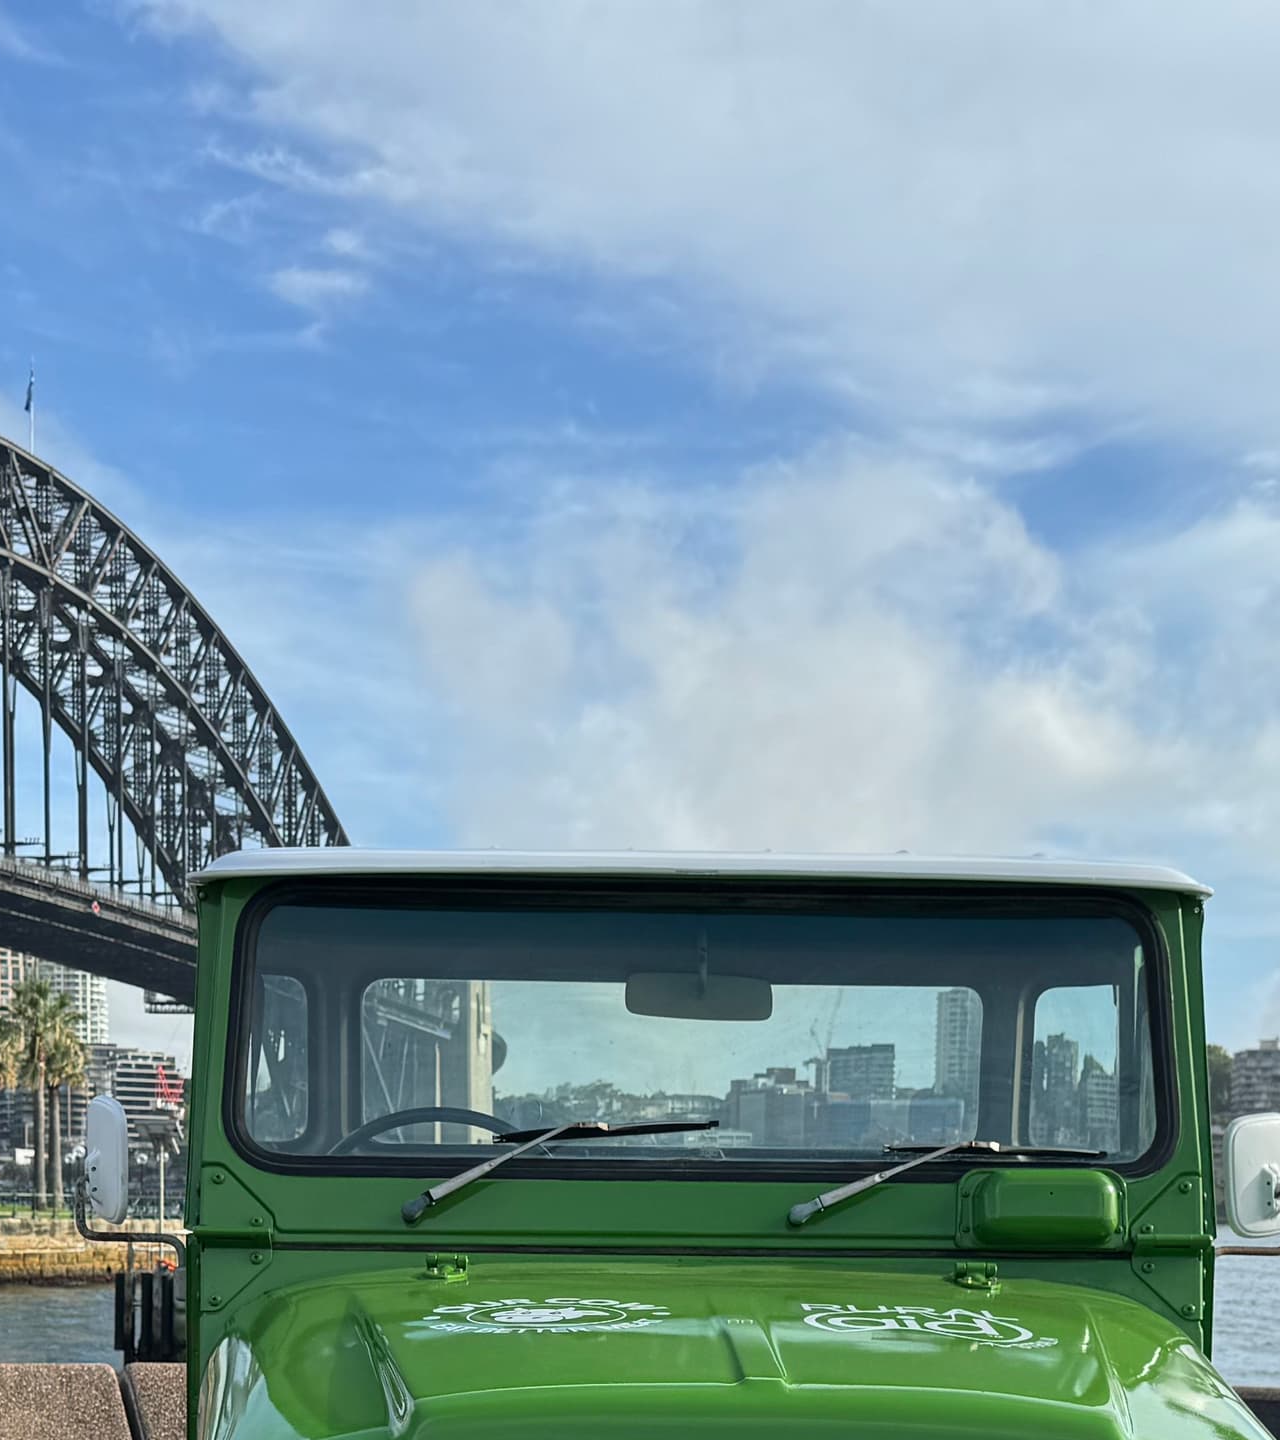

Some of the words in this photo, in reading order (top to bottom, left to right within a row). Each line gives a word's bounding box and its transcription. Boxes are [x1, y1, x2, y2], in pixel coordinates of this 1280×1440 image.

[433, 1298, 537, 1313] OUR
[544, 1297, 669, 1310] COW
[800, 1303, 1019, 1322] RURAL
[827, 1315, 999, 1337] aid
